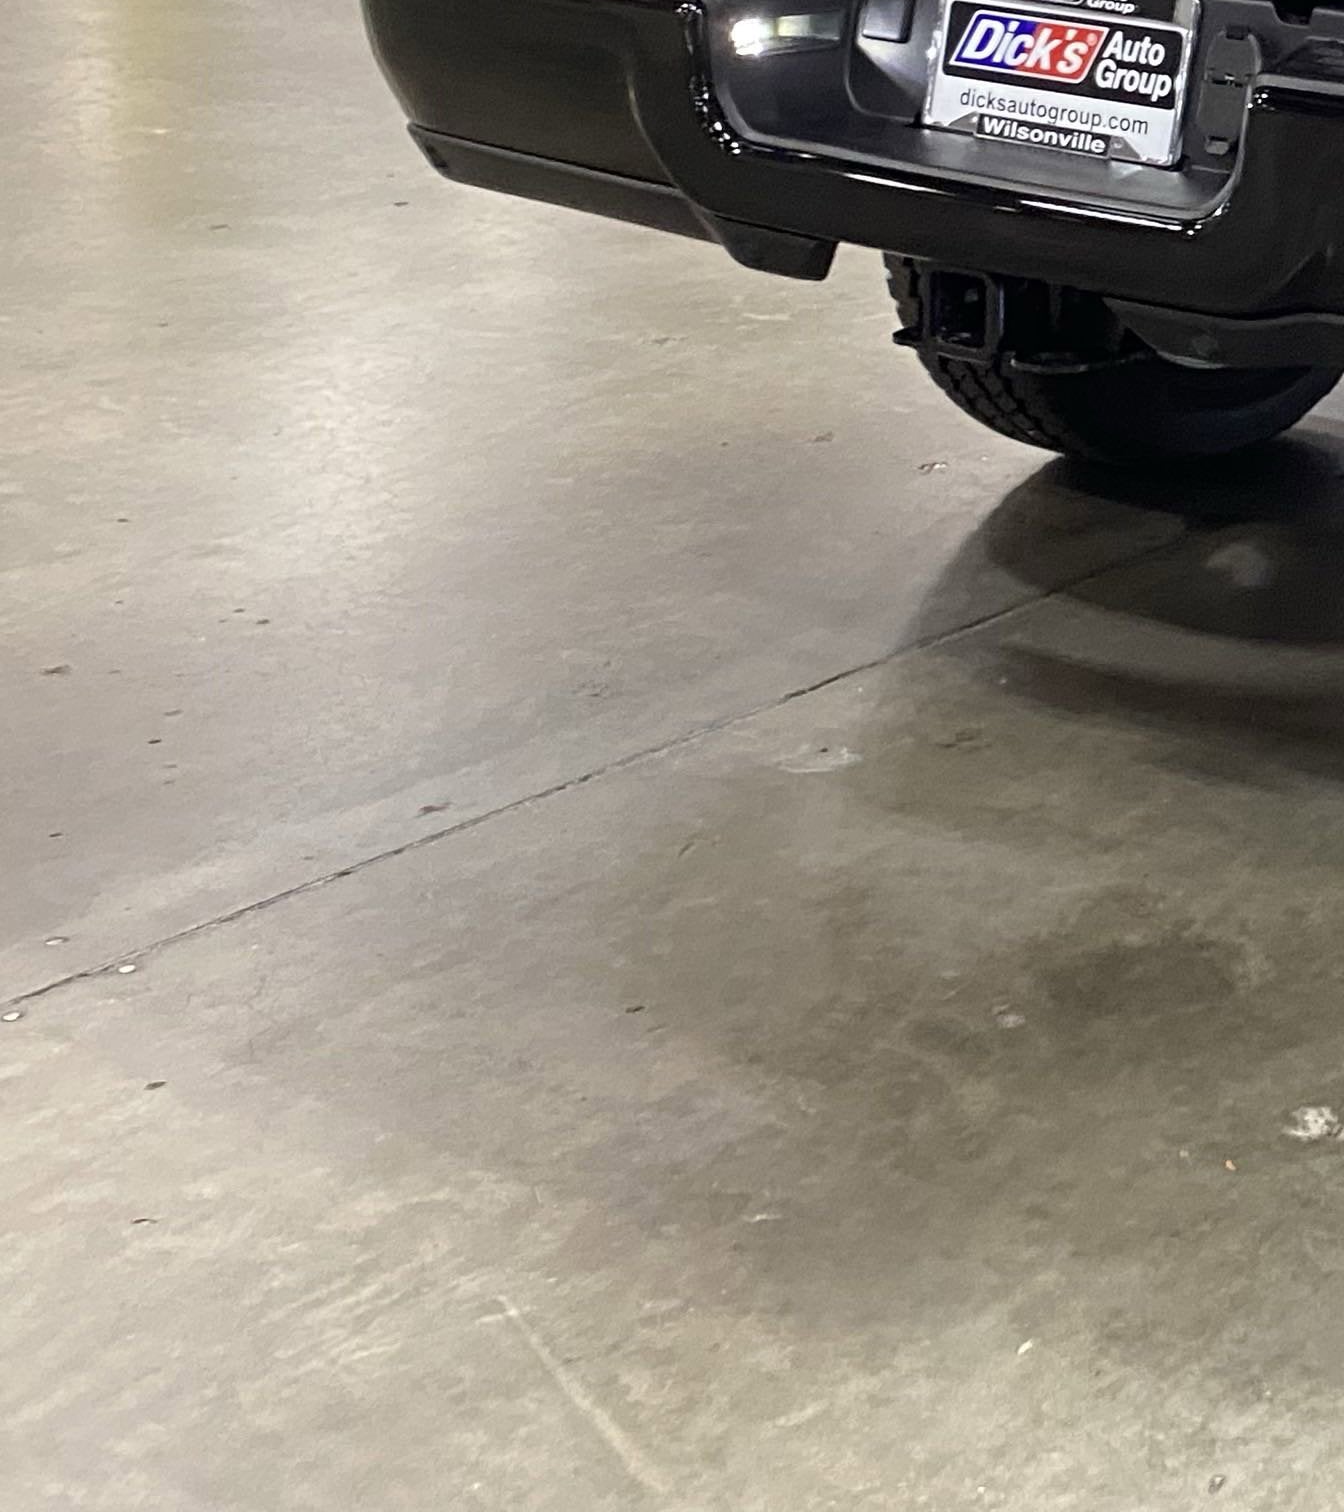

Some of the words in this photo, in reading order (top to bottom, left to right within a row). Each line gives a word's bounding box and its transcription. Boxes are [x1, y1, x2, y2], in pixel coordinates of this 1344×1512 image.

[961, 18, 1091, 75] Dick's
[1103, 31, 1166, 67] Auto
[1095, 59, 1173, 102] Group
[959, 88, 1149, 136] dicksautogroup.com
[981, 115, 1107, 154] Wilsonville
